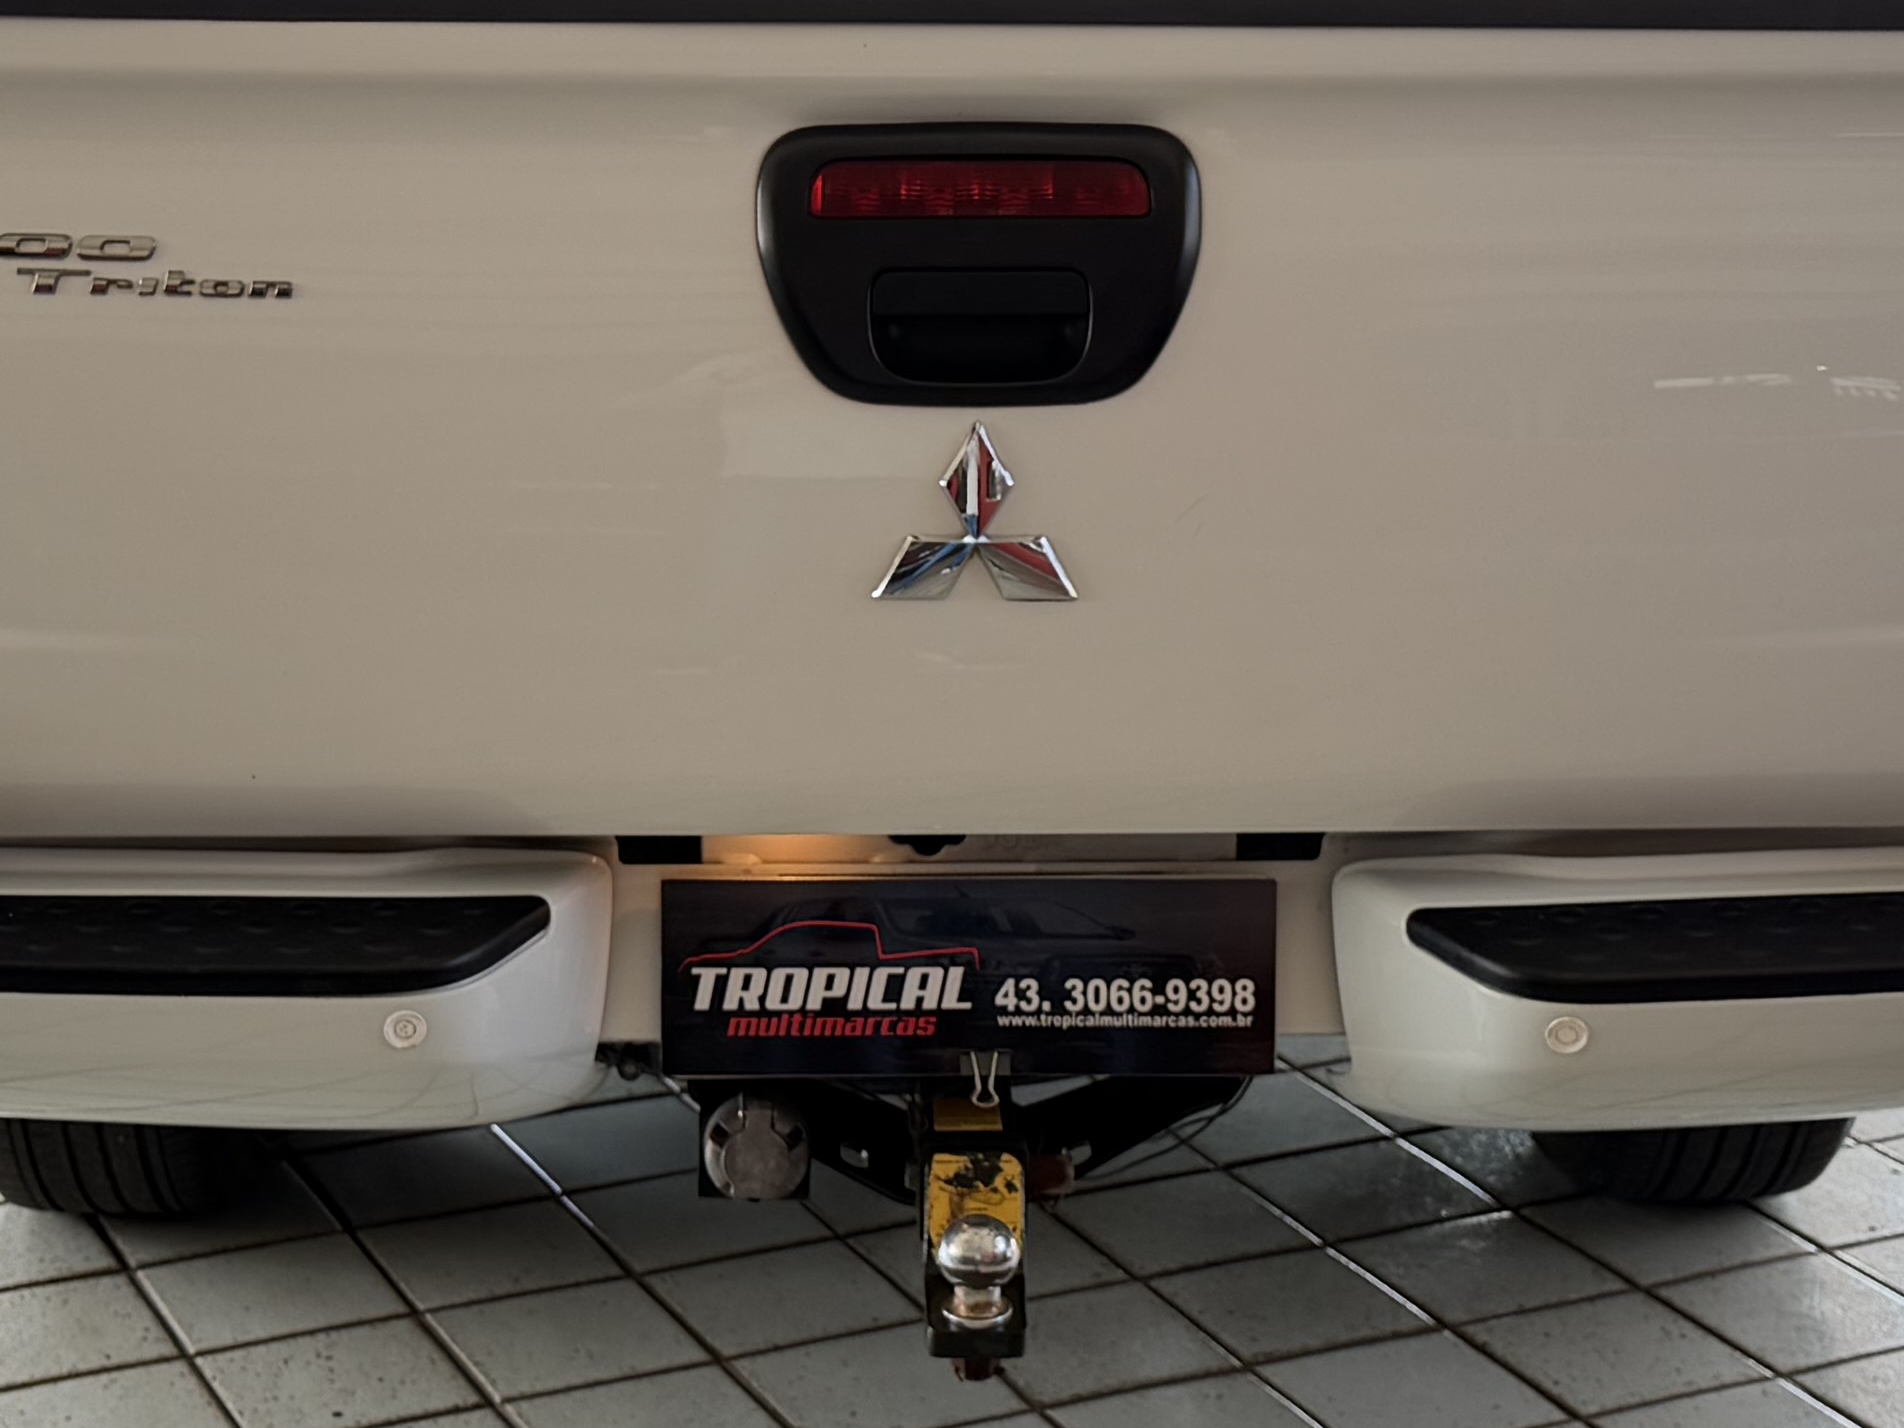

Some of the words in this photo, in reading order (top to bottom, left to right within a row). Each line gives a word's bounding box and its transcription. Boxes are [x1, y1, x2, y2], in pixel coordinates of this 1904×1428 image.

[16, 267, 294, 299] Triton
[690, 966, 973, 1011] TROPICAL
[994, 978, 1051, 1012] 43.
[1063, 978, 1256, 1013] 3066-9398
[726, 1013, 938, 1038] multimarcas
[996, 1012, 1254, 1030] www.tropicalmultimarcas.com.br
